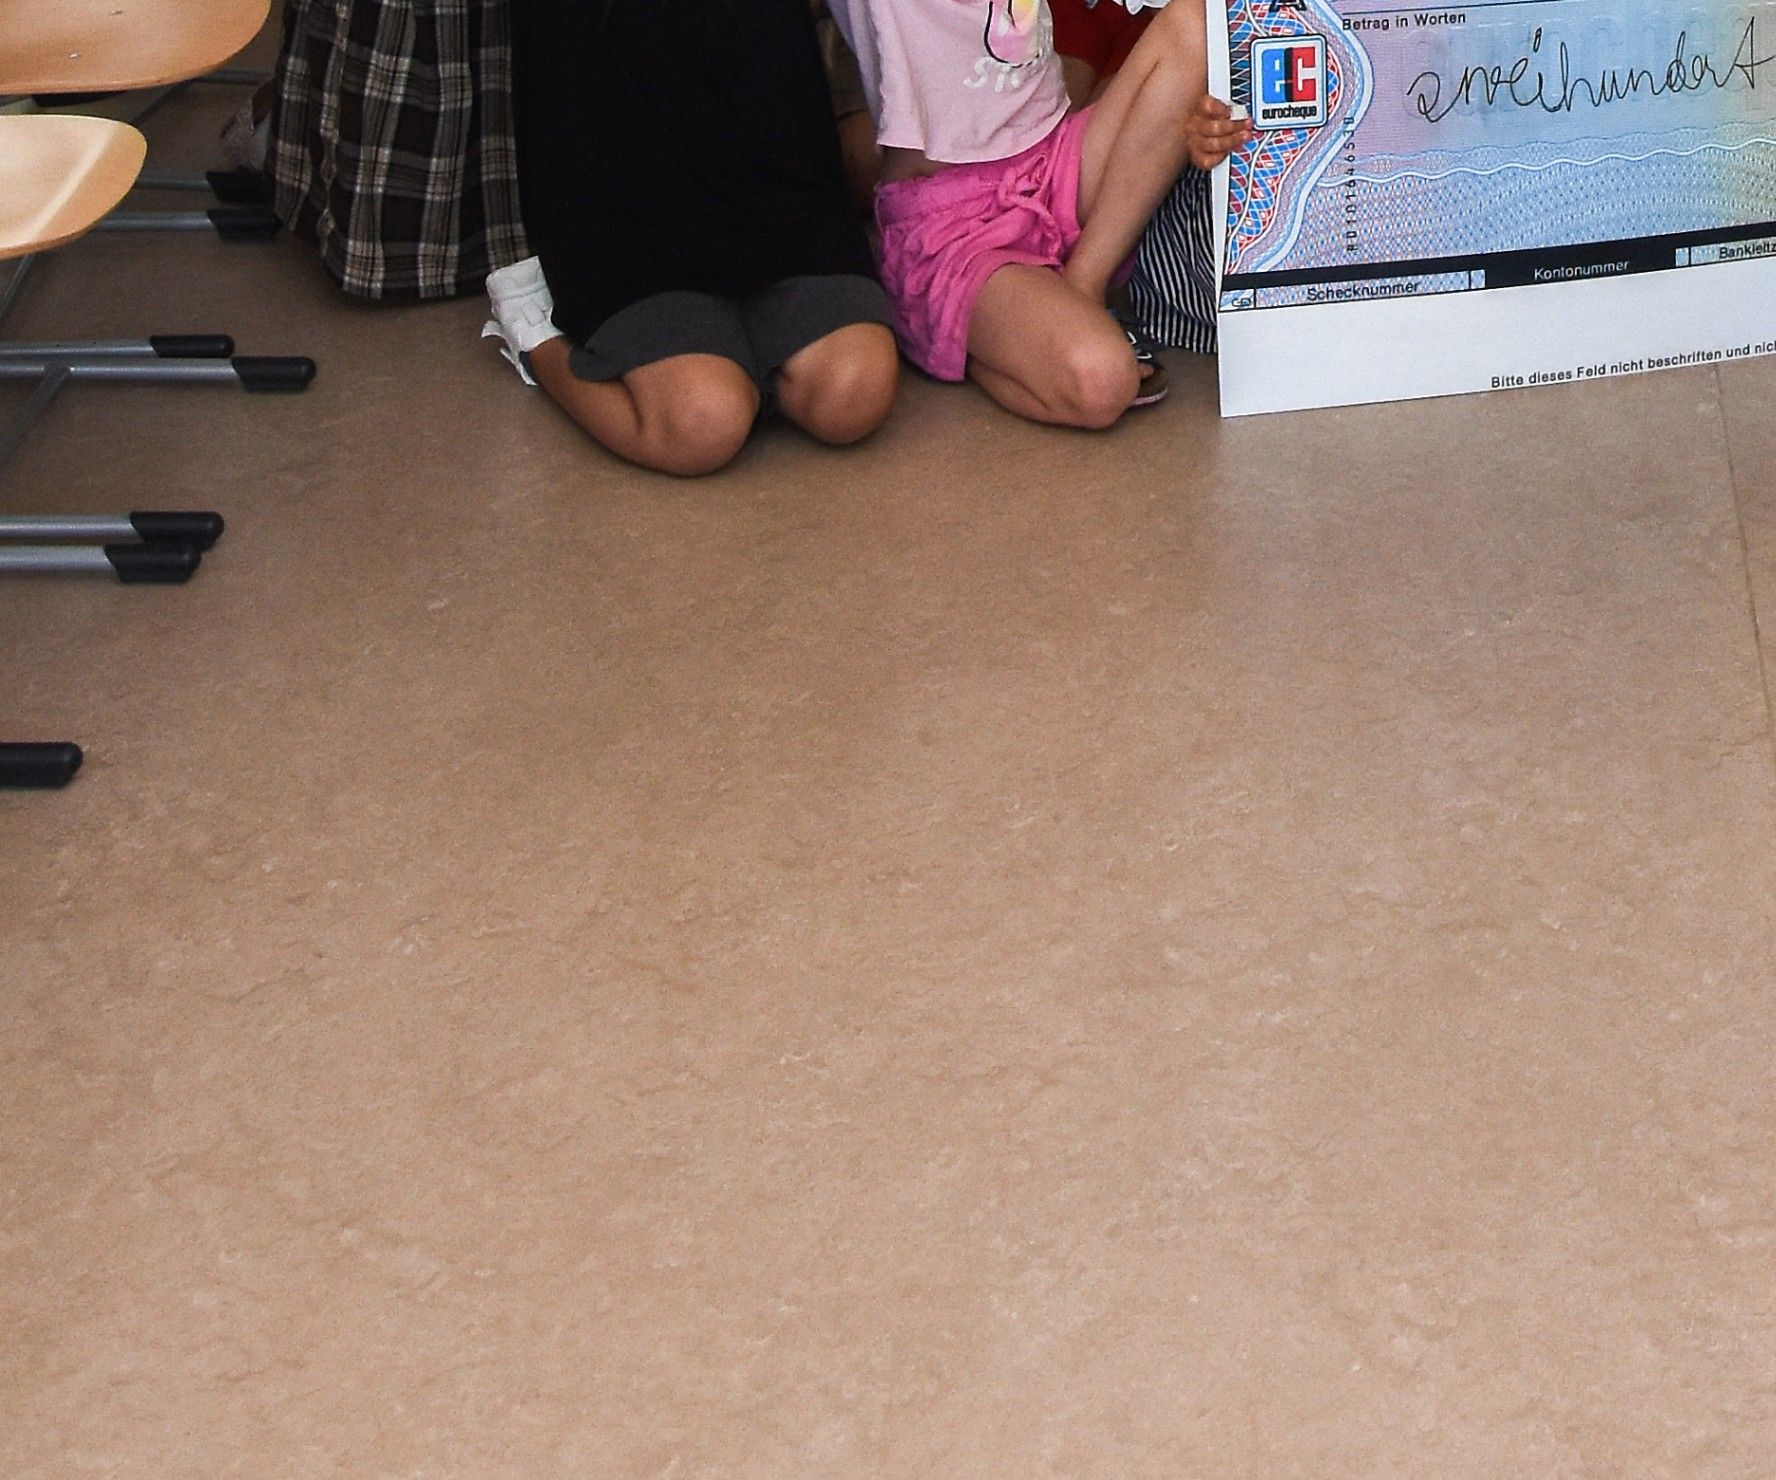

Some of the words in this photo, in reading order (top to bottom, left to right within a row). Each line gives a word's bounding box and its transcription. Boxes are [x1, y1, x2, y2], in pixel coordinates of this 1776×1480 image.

[1342, 15, 1390, 31] Betrag
[1395, 13, 1409, 27] in
[1415, 11, 1466, 26] Worten
[1262, 104, 1318, 120] eurocheque
[1533, 259, 1630, 281] Kontonummer
[1306, 279, 1421, 302] Schecknummer
[1491, 373, 1524, 389] Bitte
[1528, 367, 1573, 385] dieses
[1576, 363, 1606, 379] Feld
[1610, 358, 1644, 374] nicht
[1648, 348, 1722, 370] beschriften
[1726, 343, 1750, 359] und
